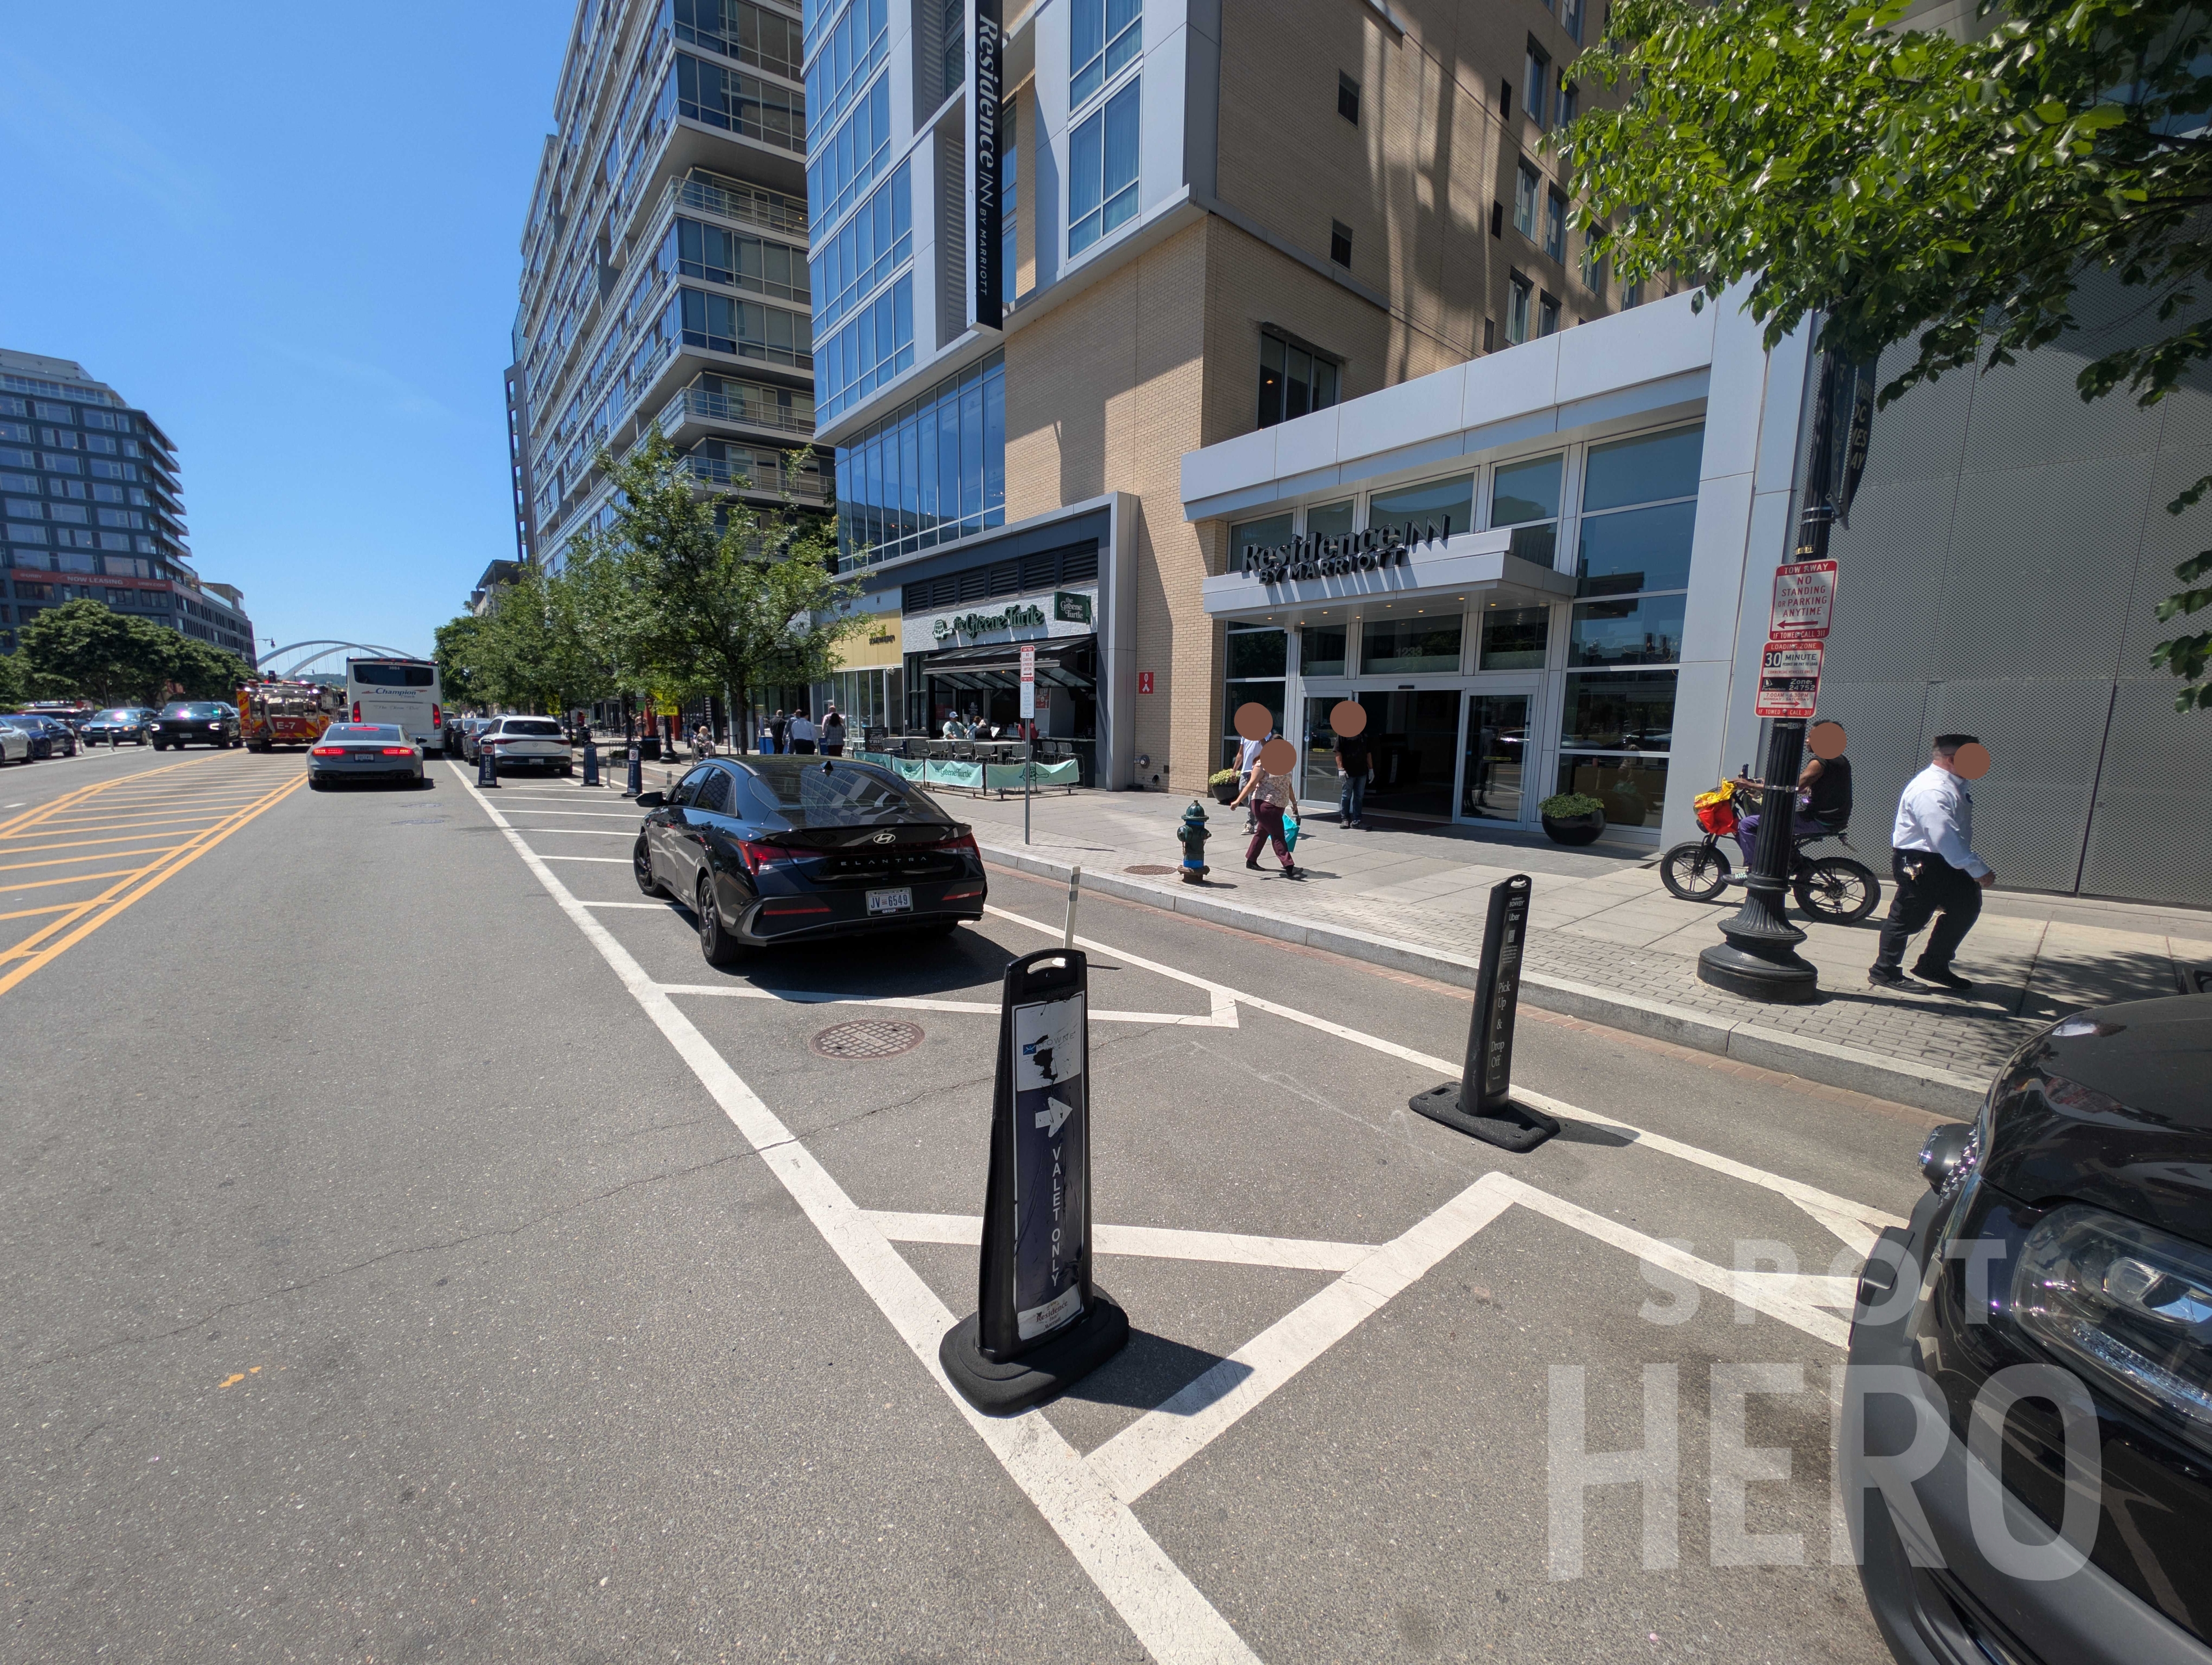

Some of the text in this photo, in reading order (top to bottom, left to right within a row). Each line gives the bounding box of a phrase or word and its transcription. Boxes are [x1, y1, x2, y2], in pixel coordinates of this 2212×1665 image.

[979, 13, 998, 296] Residence INN BY MARRIOTT
[1241, 514, 1451, 573] Residence INN
[1259, 547, 1407, 585] BY MARRIOTT
[1785, 566, 1801, 574] TOW
[1797, 576, 1812, 585] NO
[1781, 585, 1826, 597] STANDING
[1060, 601, 1083, 611] Greene
[1787, 596, 1827, 607] PARKING
[1065, 609, 1084, 619] Turtle
[1782, 606, 1822, 617] ANYTIME
[953, 604, 1045, 639] the Greene Turtle
[1764, 652, 1782, 666] 30
[376, 688, 416, 696] Champion
[276, 722, 296, 730] E-7
[940, 768, 957, 777] Greene
[956, 768, 972, 778] Turtle
[841, 856, 926, 866] ELANTRA
[871, 894, 908, 908] JV 6549
[1509, 913, 1520, 921] Uber
[1498, 981, 1510, 994] Pick
[1498, 996, 1506, 1011] Up
[1497, 1019, 1502, 1029] &
[1491, 1040, 1505, 1053] Drop
[1491, 1055, 1501, 1068] Off
[1051, 1146, 1061, 1287] VALET ONLY
[1036, 1301, 1068, 1322] Residence
[1043, 1317, 1061, 1331] Marriott
